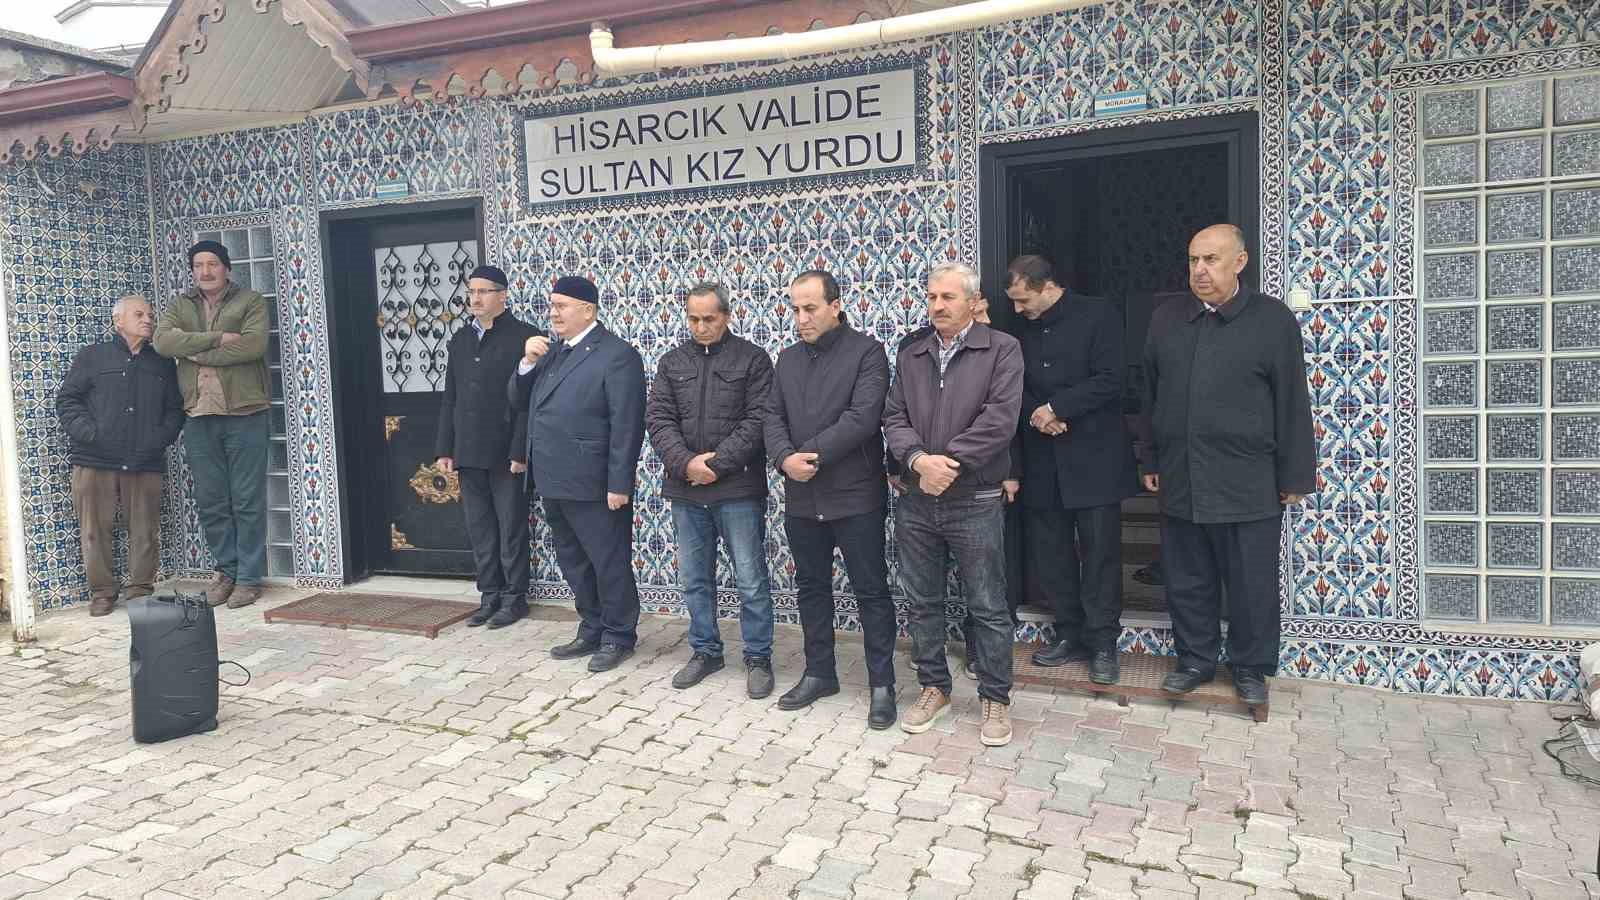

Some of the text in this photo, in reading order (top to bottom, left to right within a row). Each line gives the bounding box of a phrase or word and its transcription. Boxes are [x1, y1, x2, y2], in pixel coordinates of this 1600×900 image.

[553, 85, 881, 154] HİSARCIK VALİDE
[540, 130, 903, 197] SULTAN KIZ YURDU
